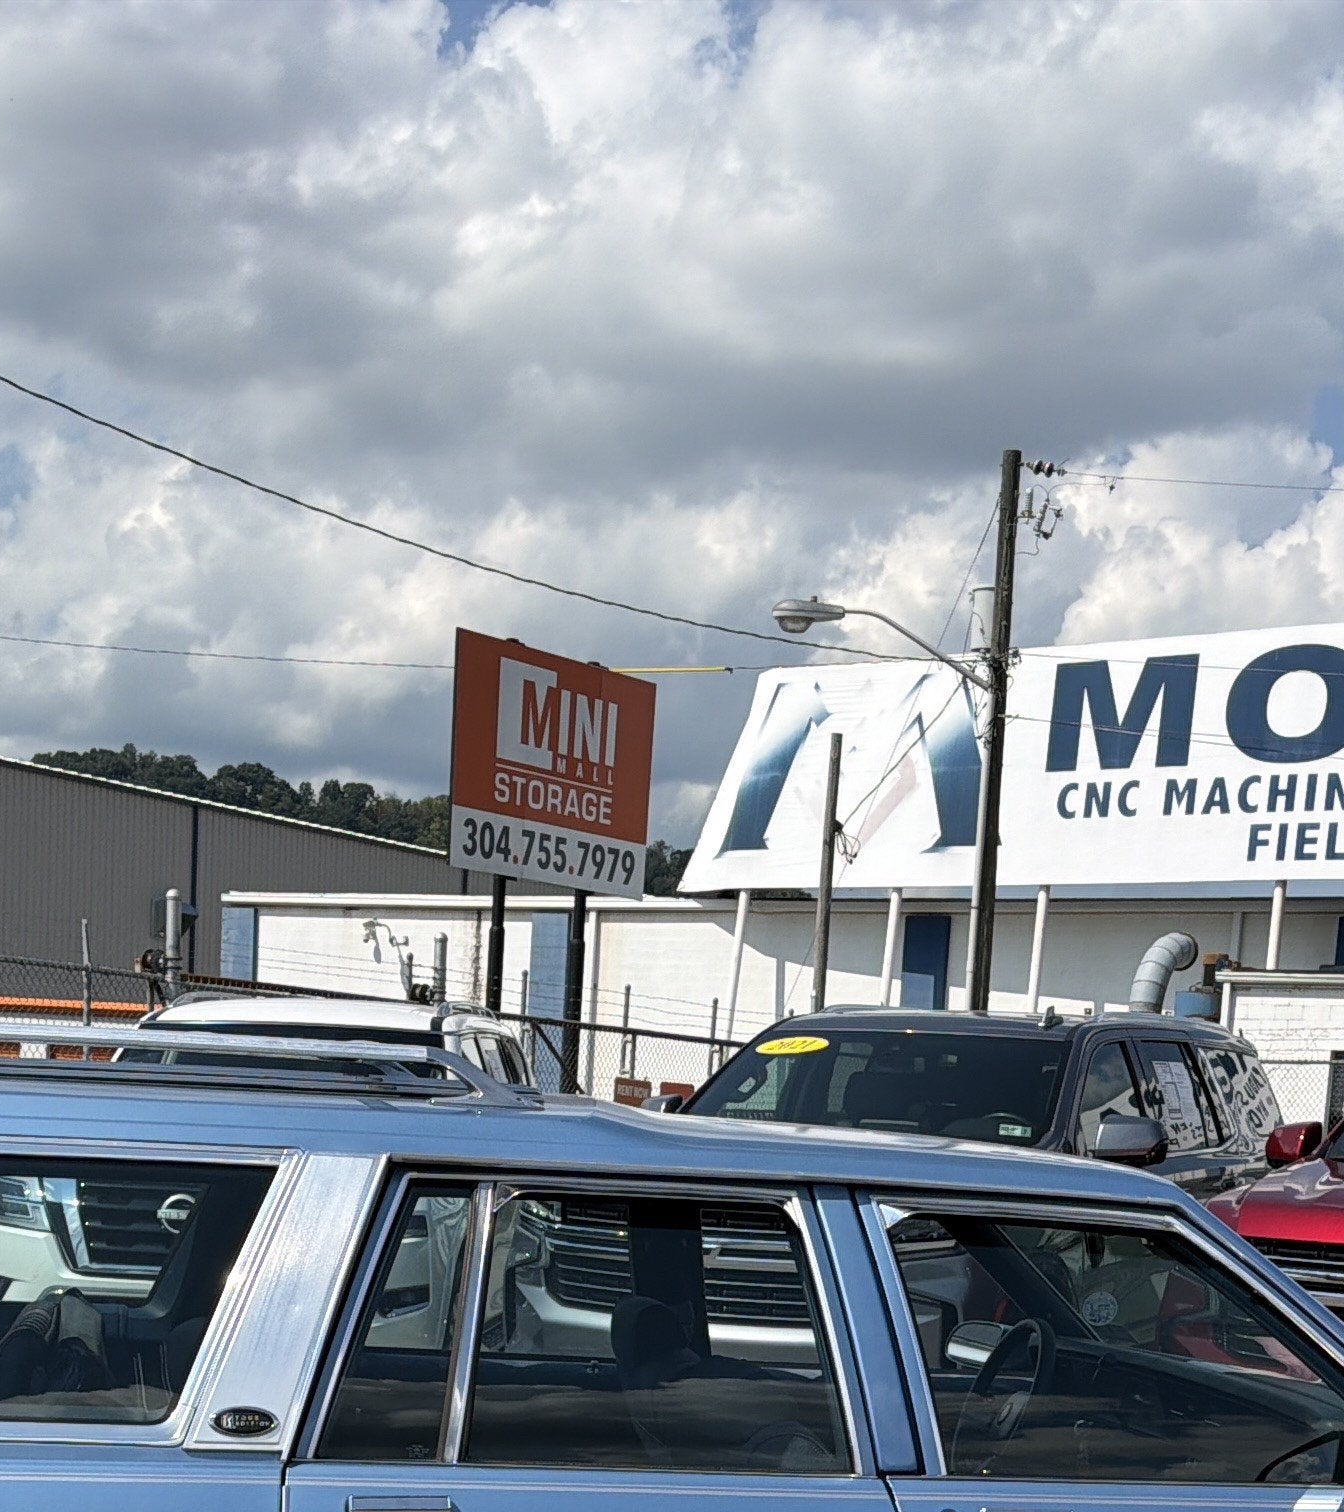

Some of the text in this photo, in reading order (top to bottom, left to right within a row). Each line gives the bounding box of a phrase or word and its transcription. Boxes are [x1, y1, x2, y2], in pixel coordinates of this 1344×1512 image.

[496, 656, 618, 770] MINI
[556, 755, 614, 787] MALL
[494, 772, 613, 826] STORAGE
[1058, 779, 1139, 820] CNC
[461, 817, 635, 886] 304.755.7979
